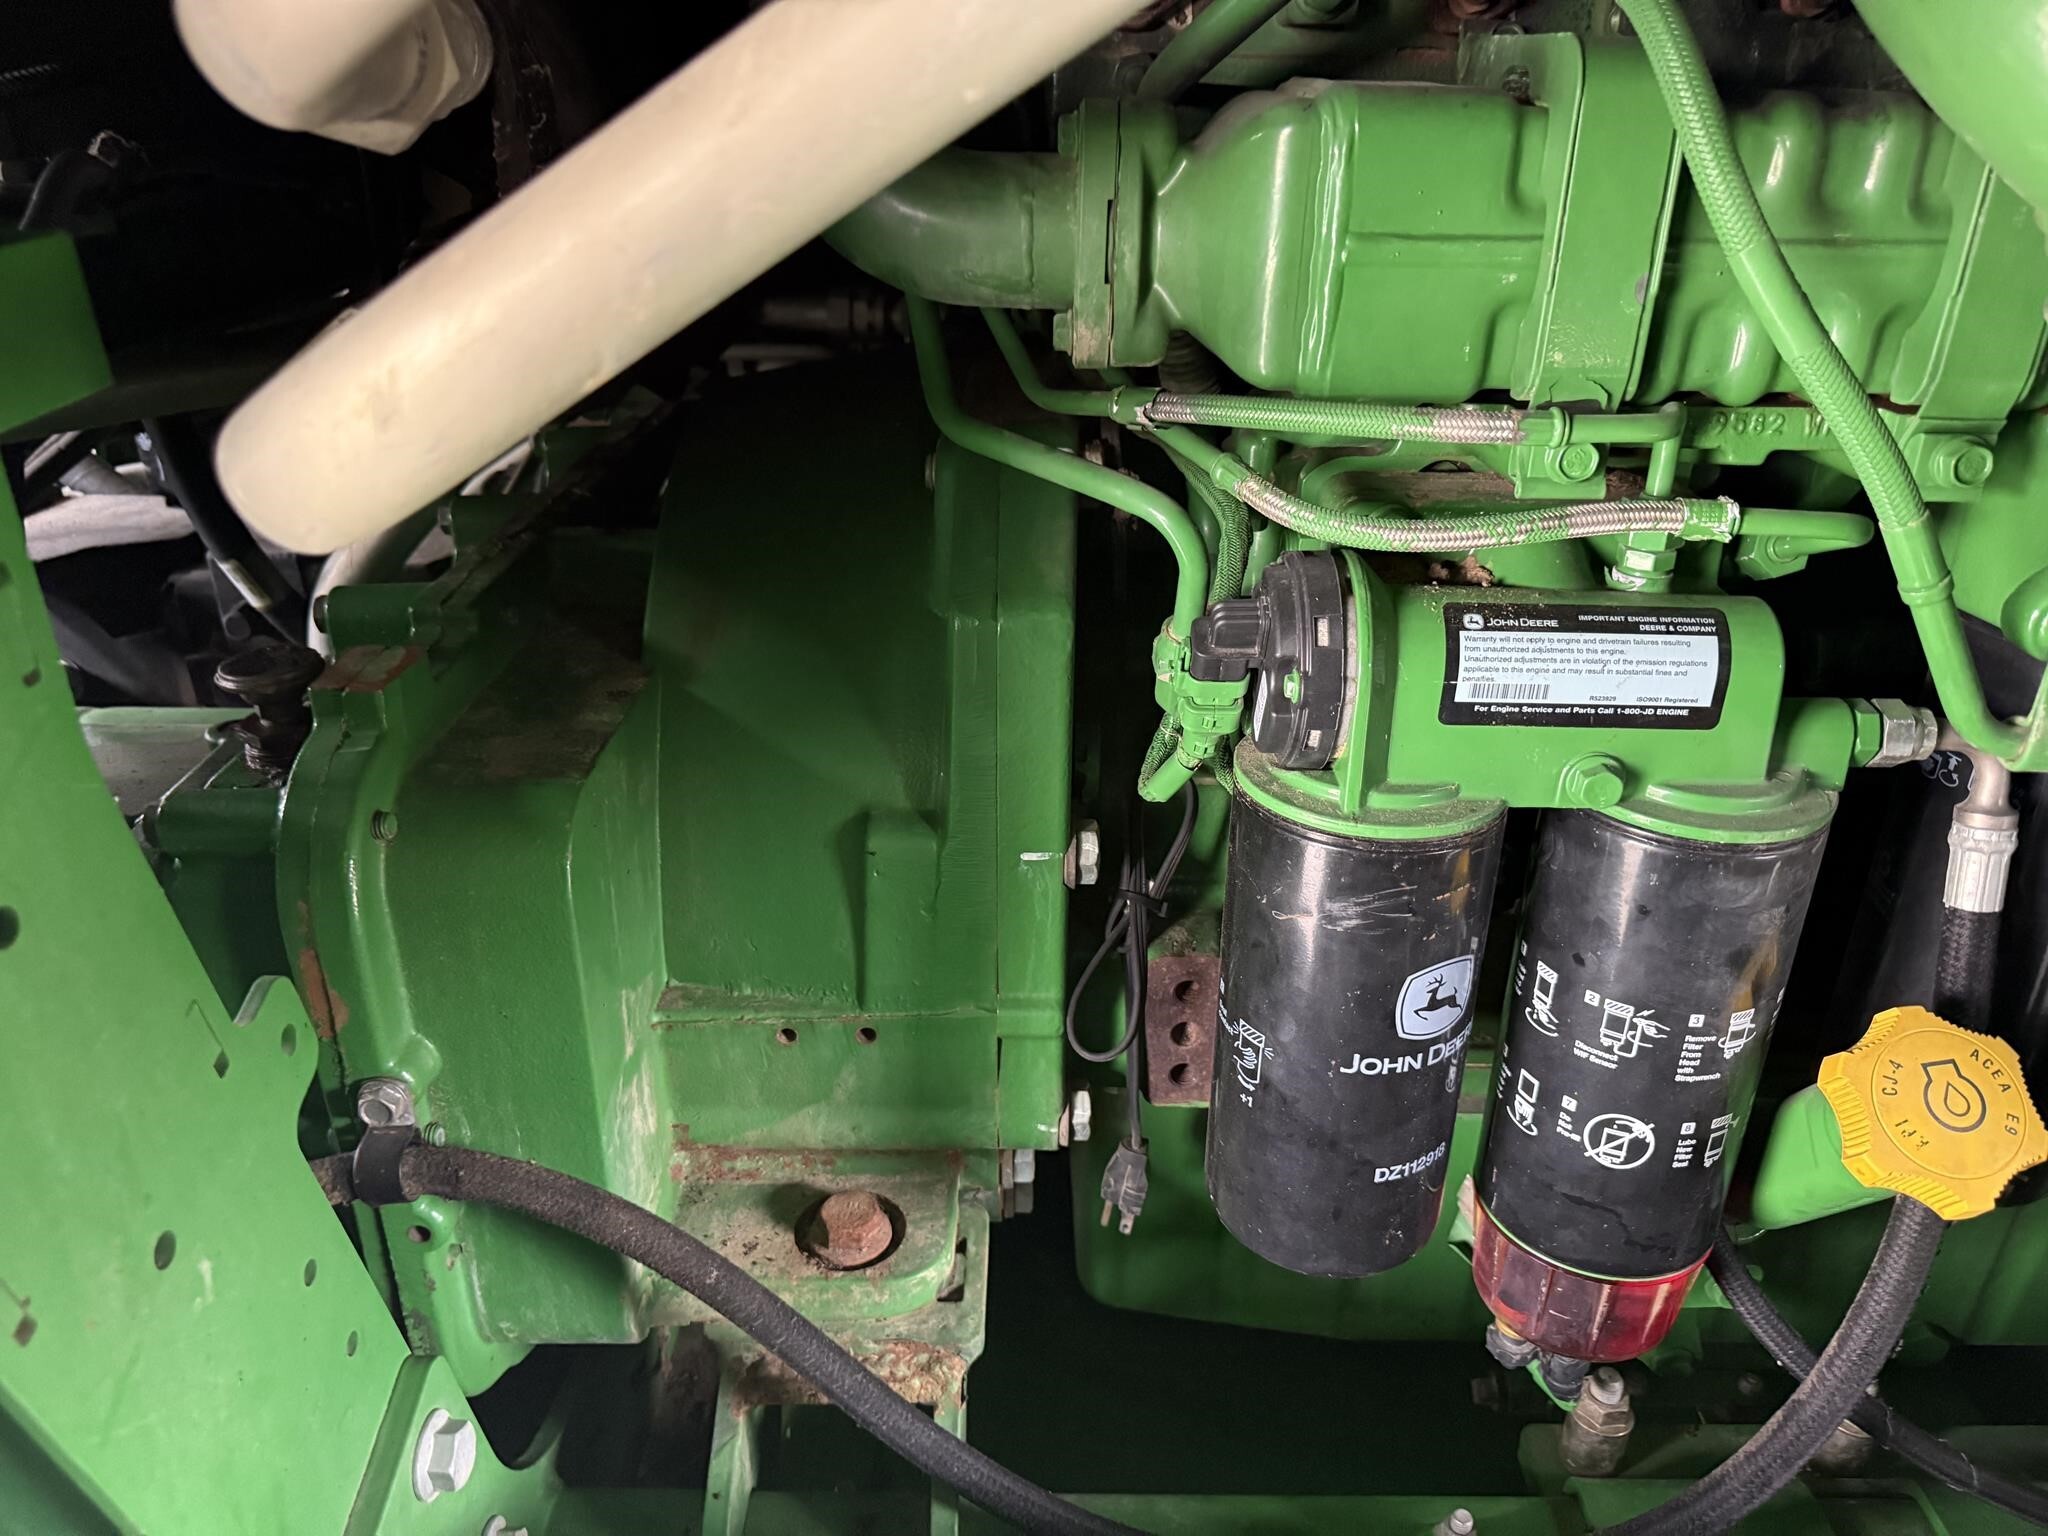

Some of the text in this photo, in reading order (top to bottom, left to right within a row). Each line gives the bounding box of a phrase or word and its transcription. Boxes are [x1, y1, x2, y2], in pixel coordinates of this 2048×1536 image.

[1487, 617, 1559, 628] JOHN DEERE
[1659, 617, 1715, 625] INFORMATION
[1464, 635, 1497, 644] Warranty
[1526, 637, 1545, 645] apply
[1556, 638, 1580, 646] engine
[1633, 638, 1659, 646] failures
[1661, 639, 1691, 647] resulting
[1531, 646, 1575, 655] adjustments
[1600, 648, 1626, 656] engine.
[1514, 656, 1557, 664] adjustments
[1669, 660, 1708, 668] regulations
[1463, 665, 1500, 674] applicable
[1525, 667, 1550, 675] engine
[1567, 668, 1583, 676] may
[1615, 668, 1654, 676] substantial
[1673, 669, 1688, 677] and
[1490, 705, 1519, 714] Engine
[1521, 705, 1553, 713] Service
[1617, 707, 1655, 715] 1-800-JD
[1340, 1052, 1423, 1075] JOHN
[1882, 1059, 1904, 1097] CJ-4
[1969, 1048, 2020, 1137] ACEA E9
[1374, 1141, 1446, 1183] DZ112918
